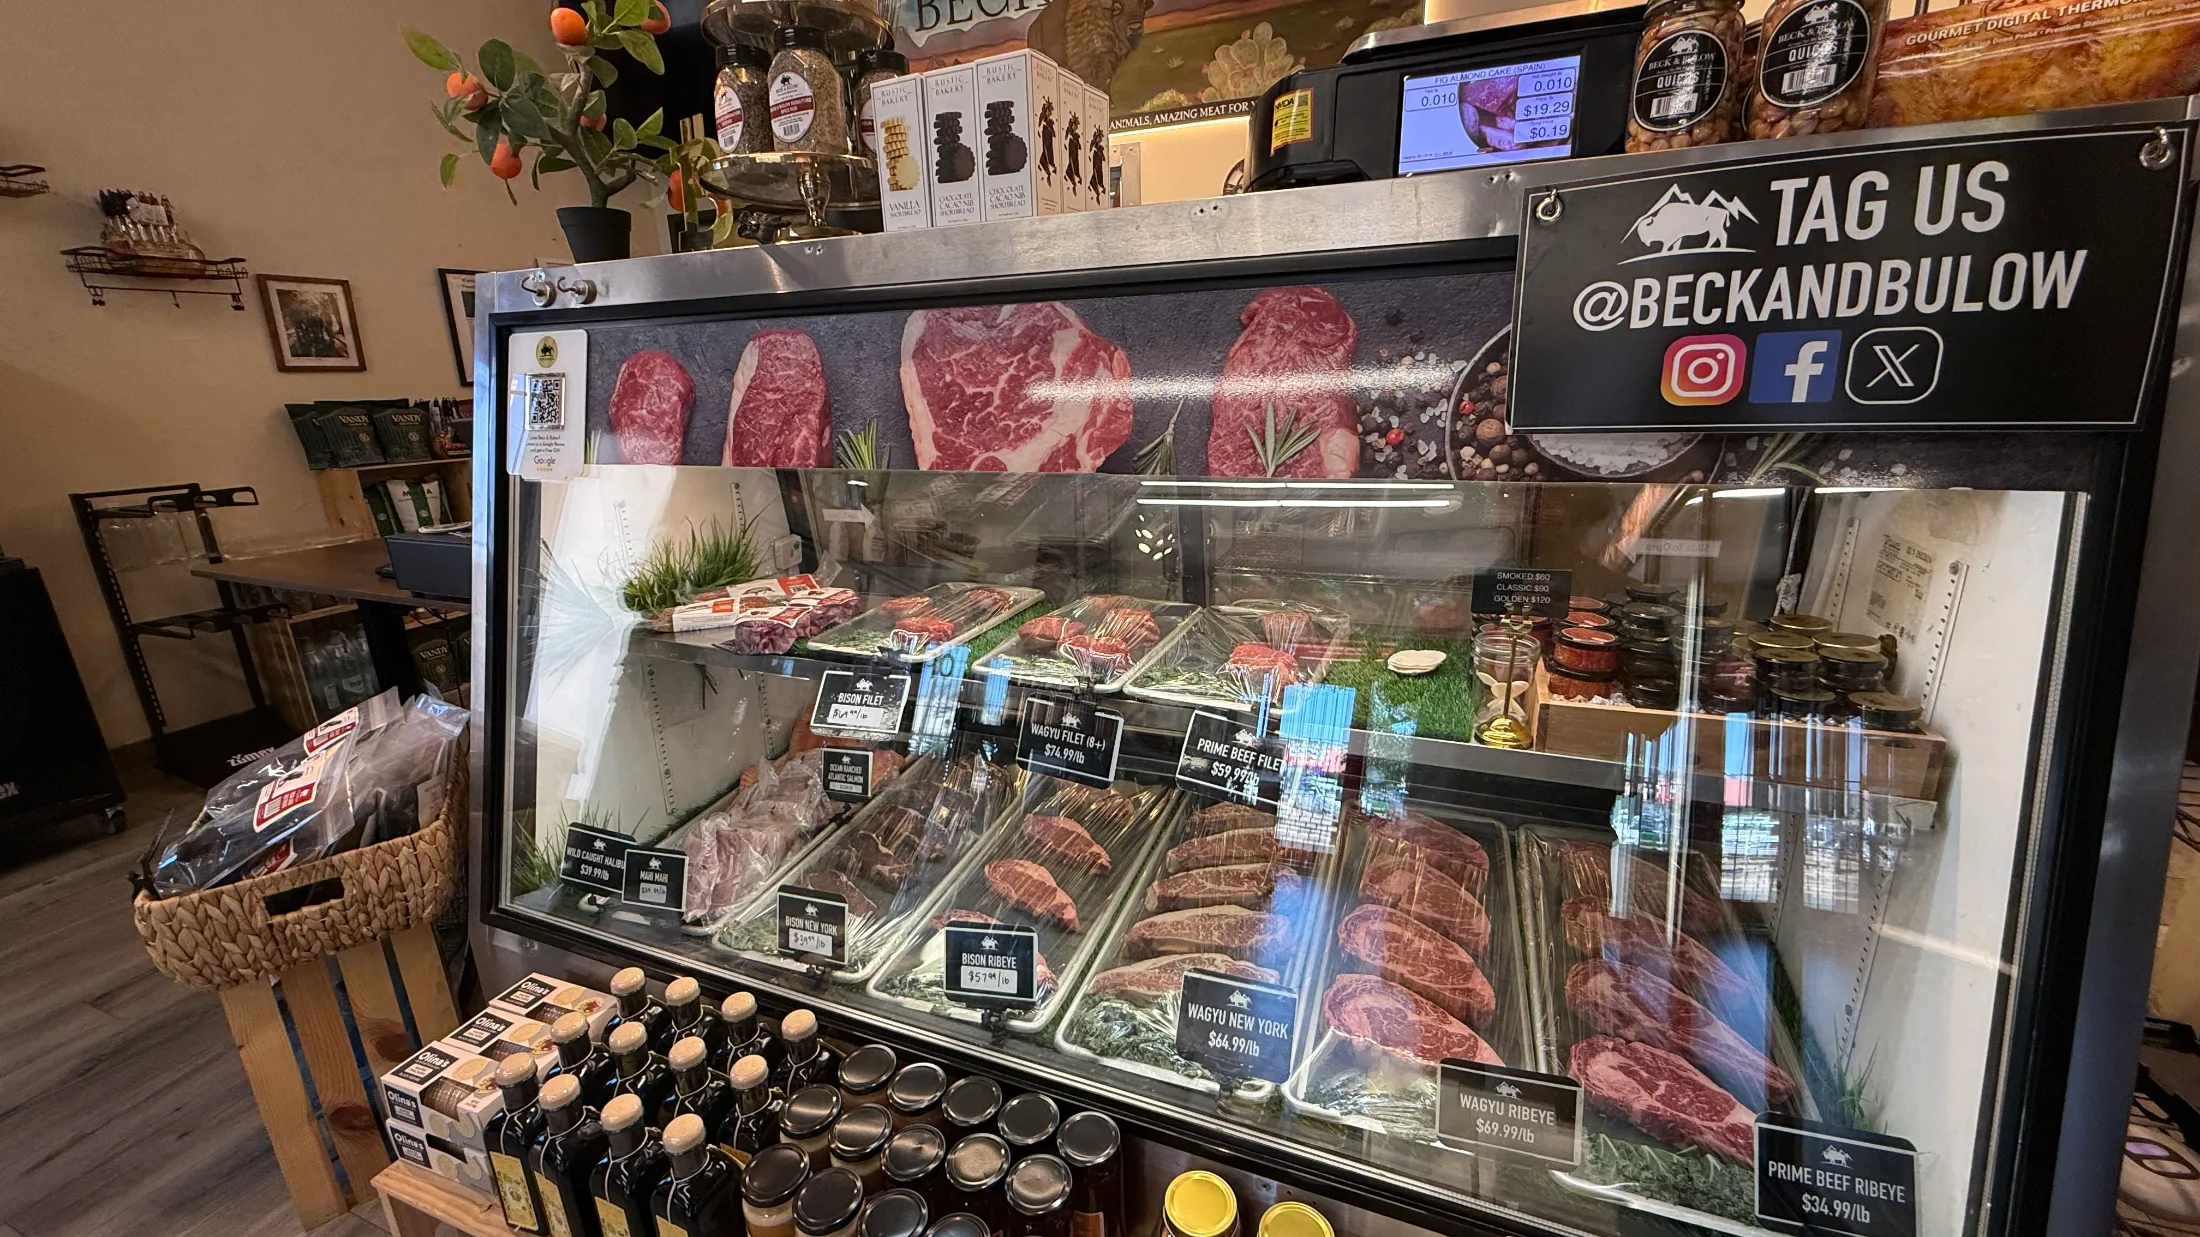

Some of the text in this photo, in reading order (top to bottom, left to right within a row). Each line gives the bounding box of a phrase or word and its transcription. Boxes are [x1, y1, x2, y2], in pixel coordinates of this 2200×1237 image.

[915, 0, 1052, 32] BEC
[2015, 30, 2037, 40] Probe
[2045, 23, 2081, 35] Premium
[2083, 16, 2120, 27] Stainless
[2122, 11, 2145, 20] Steel
[2147, 6, 2173, 17] Probe
[1778, 30, 1805, 43] BECK
[1807, 28, 1815, 36] &
[1905, 21, 1983, 46] GOURMET
[1987, 11, 2051, 32] DIGITAL
[986, 64, 1016, 76] RUSTIC
[1649, 59, 1671, 71] BECK
[1673, 57, 1680, 65] &
[934, 76, 964, 87] RUSTIC
[987, 72, 1017, 85] BAKERY
[1435, 63, 1546, 85] FIG ALMOND CAKE (SPAIN)
[935, 85, 964, 96] BAKERY
[1534, 77, 1572, 92] 0.010
[881, 87, 908, 98] RUSTIC
[881, 95, 909, 106] BAKERY
[1421, 93, 1456, 108] 0.010
[1153, 108, 1198, 124] AMAZING
[1199, 104, 1227, 117] MEAT
[1228, 101, 1249, 114] FOR
[1523, 101, 1570, 117] $19.29
[1529, 124, 1568, 140] $0.19
[939, 192, 973, 203] CHOCOLATE
[989, 185, 1025, 196] CHOCOLATE
[889, 200, 921, 212] VANILLA
[939, 201, 961, 210] CACAO
[989, 194, 1013, 203] CACAO
[990, 200, 1026, 210] SHORTBREAD
[1769, 159, 2010, 248] TAG US
[889, 209, 921, 219] SHORTBREAD
[939, 207, 975, 217] SHORTBREAD
[1572, 249, 2089, 332] @BECKANDBULOW
[339, 414, 370, 424] VANDY
[391, 414, 422, 423] VANDY
[419, 645, 448, 659] VANDY
[837, 692, 884, 706] BISON FILET
[1031, 722, 1106, 752] WAGYU FILET (8+)
[1044, 743, 1085, 764] $74.99/lb
[1197, 738, 1230, 758] PRIME
[1230, 746, 1257, 765] BEEF
[827, 772, 864, 784] ATLANTIC SALMON
[566, 846, 625, 870] WILD CAUGHT HALIBU
[580, 863, 610, 881] $39.99/lb
[640, 870, 669, 884] MAHI MAHI
[785, 915, 838, 937] BISON NEW YORK
[961, 952, 1017, 969] BISON RIBEYE
[521, 981, 550, 995] Olina's
[475, 1017, 506, 1032] Olina's
[1187, 1002, 1289, 1040] WAGYU NEW YORK
[1208, 1029, 1260, 1058] $64.99/lb
[418, 1051, 451, 1068] Olina's
[387, 1090, 417, 1109] Olina's
[1459, 1093, 1555, 1126] WAGYU RIBEYE
[1475, 1117, 1535, 1144] $69.99/lb
[394, 1132, 424, 1151] Olina's
[1768, 1160, 1906, 1203] PRIME BEEF RIBEYE
[1801, 1192, 1871, 1224] $34.99/lb
